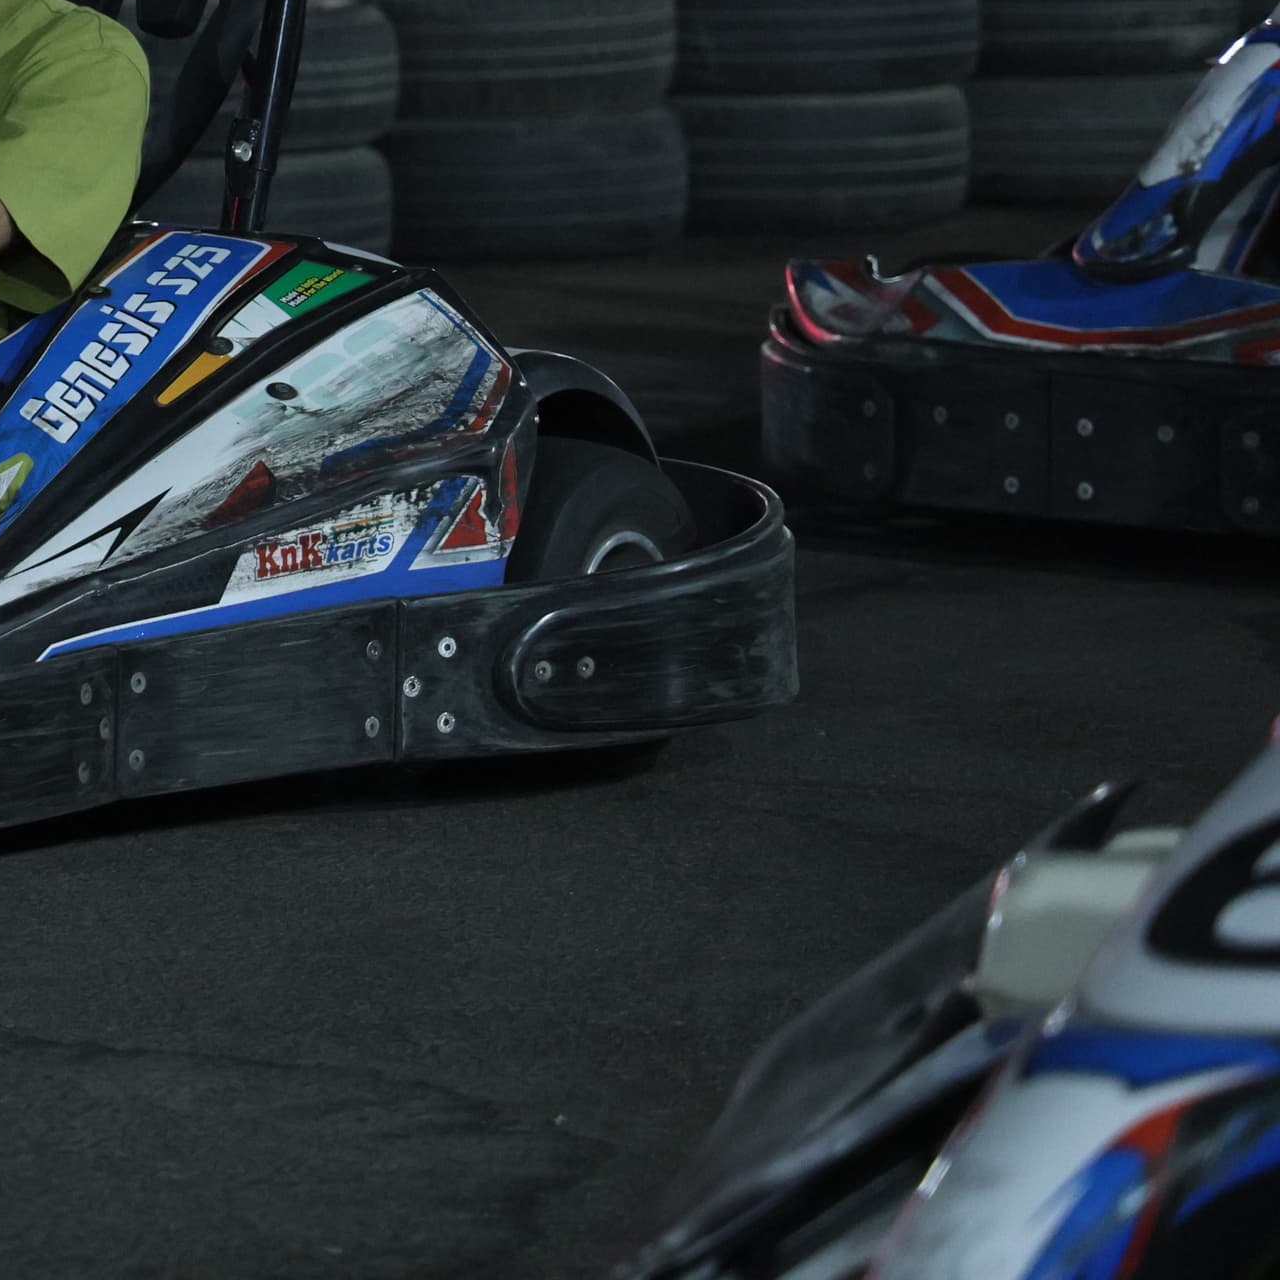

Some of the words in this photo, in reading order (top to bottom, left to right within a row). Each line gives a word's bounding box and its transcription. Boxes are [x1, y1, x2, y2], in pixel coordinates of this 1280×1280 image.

[145, 243, 232, 296] S25
[255, 531, 324, 579] KnK
[326, 533, 392, 564] karts
